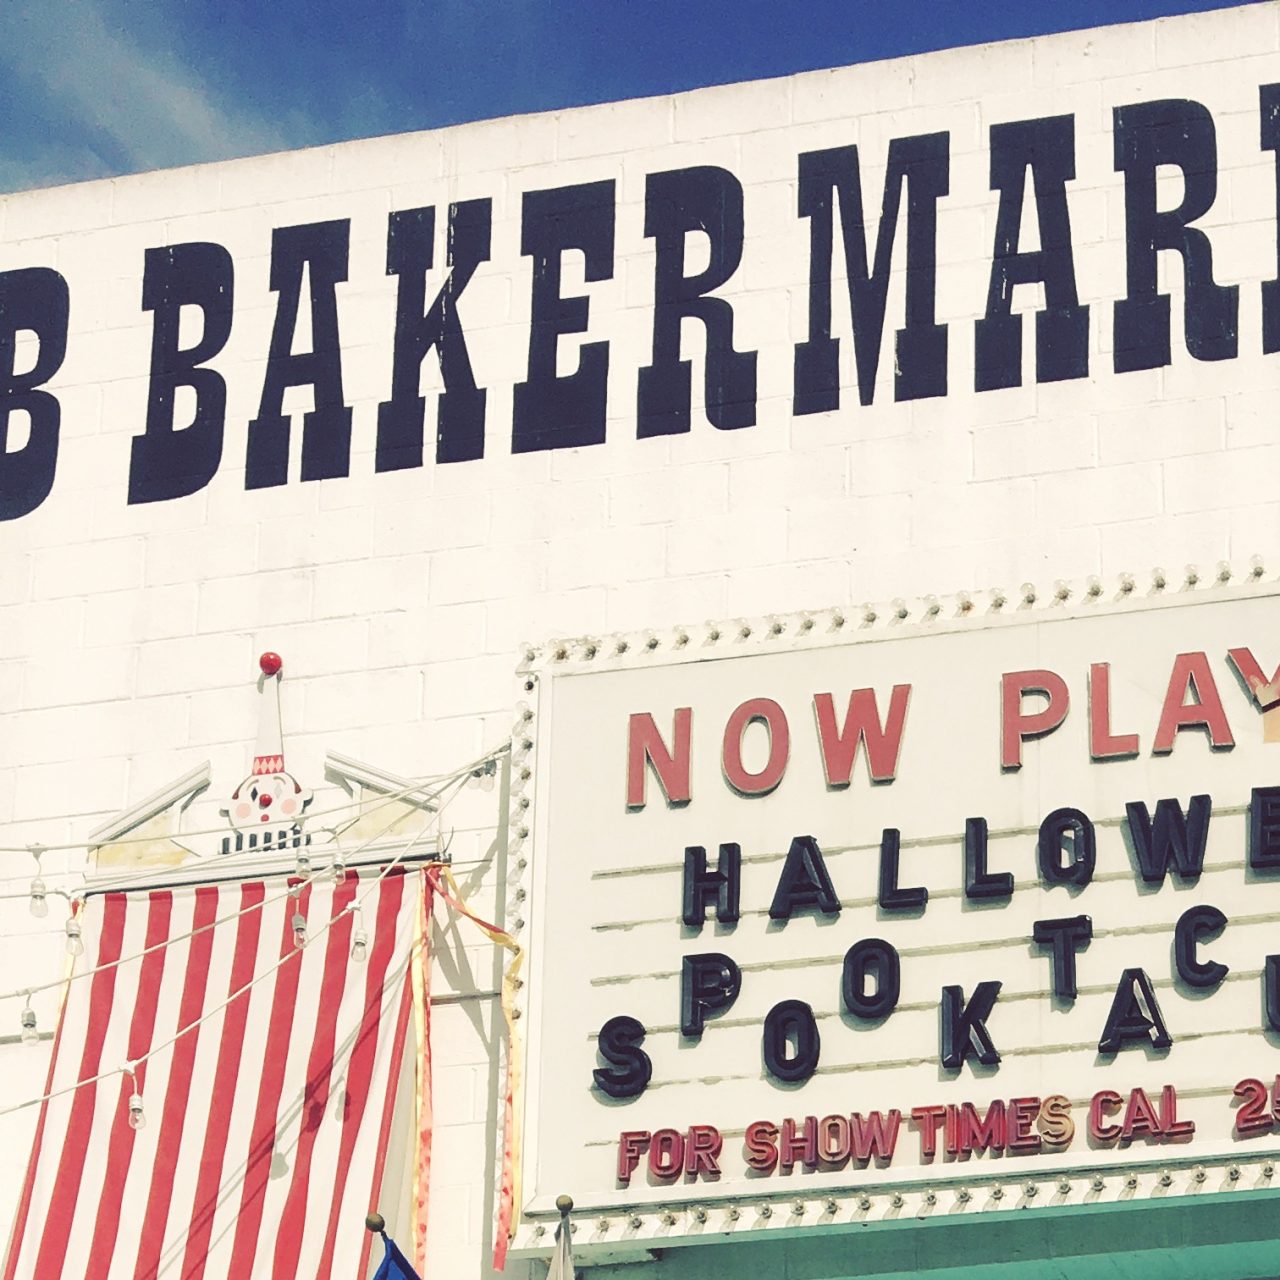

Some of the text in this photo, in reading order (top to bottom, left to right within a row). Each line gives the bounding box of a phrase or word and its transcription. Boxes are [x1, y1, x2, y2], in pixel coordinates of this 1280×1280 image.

[128, 166, 757, 506] BAKER
[627, 684, 912, 806] NOW
[617, 1124, 724, 1182] FOR
[1089, 1083, 1197, 1140] CAL
